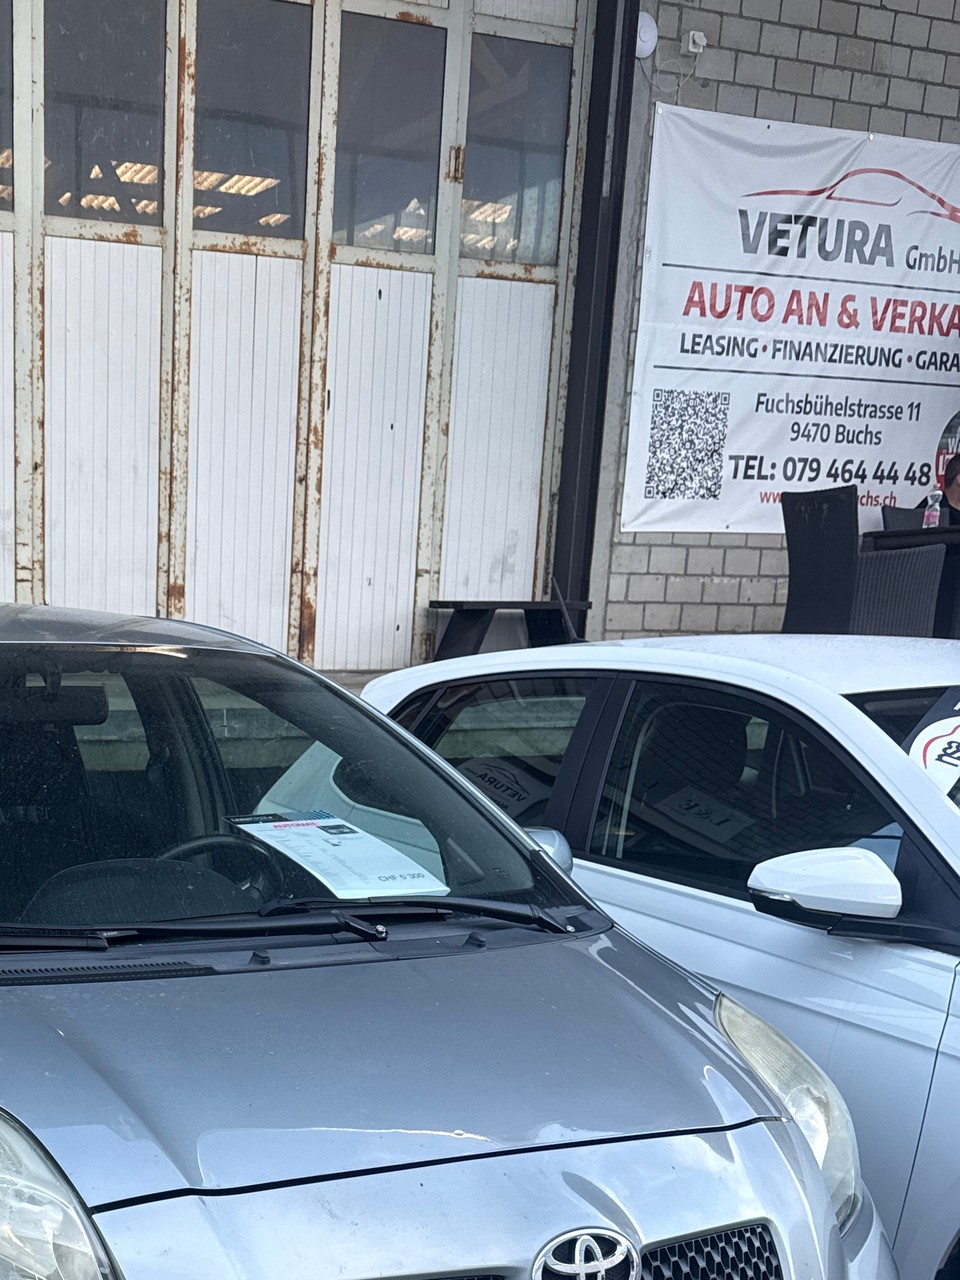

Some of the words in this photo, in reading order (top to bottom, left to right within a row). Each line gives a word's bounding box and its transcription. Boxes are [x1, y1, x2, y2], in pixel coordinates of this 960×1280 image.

[738, 209, 895, 268] VETURA
[905, 244, 960, 275] GmbH
[682, 280, 776, 323] AUTO
[781, 288, 830, 327] AN
[837, 293, 860, 329] &
[679, 332, 759, 359] LEASING
[771, 339, 903, 369] FINANZIERUNG
[754, 392, 904, 421] Fuchsbühelstrasse
[907, 401, 922, 422] 11
[789, 421, 831, 443] 9470
[834, 423, 883, 446] Buchs
[728, 454, 777, 482] TEL:
[782, 456, 822, 483] 079
[826, 458, 868, 485] 464
[872, 460, 900, 486] 44
[903, 461, 933, 487] 48
